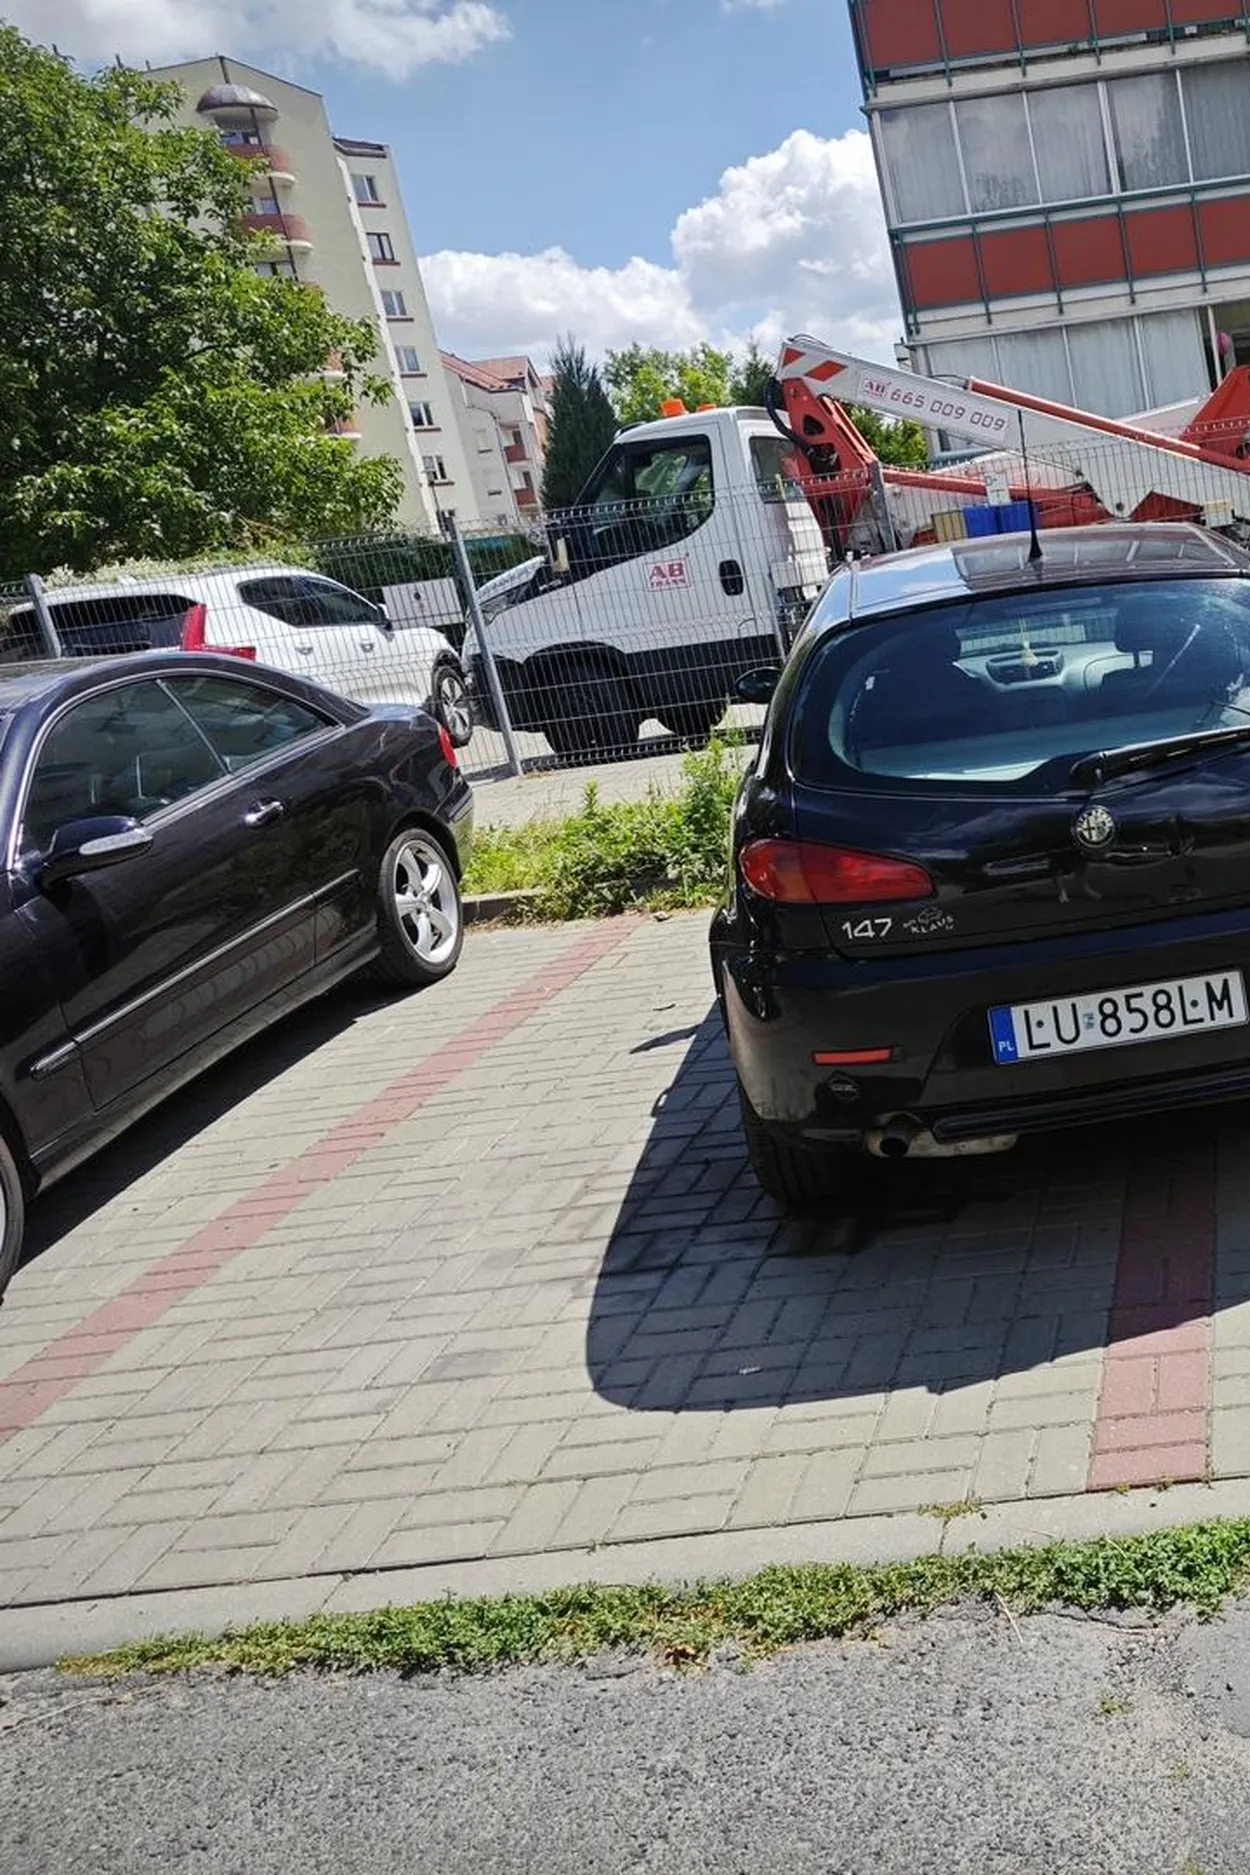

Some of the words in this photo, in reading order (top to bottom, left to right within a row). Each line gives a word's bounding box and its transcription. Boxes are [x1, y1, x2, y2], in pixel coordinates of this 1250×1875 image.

[890, 388, 925, 408] 665
[930, 400, 966, 420] 009
[969, 412, 1006, 431] 009
[649, 563, 685, 580] AB
[841, 918, 893, 939] 147
[1024, 1003, 1080, 1050] LU
[999, 1040, 1014, 1052] PL
